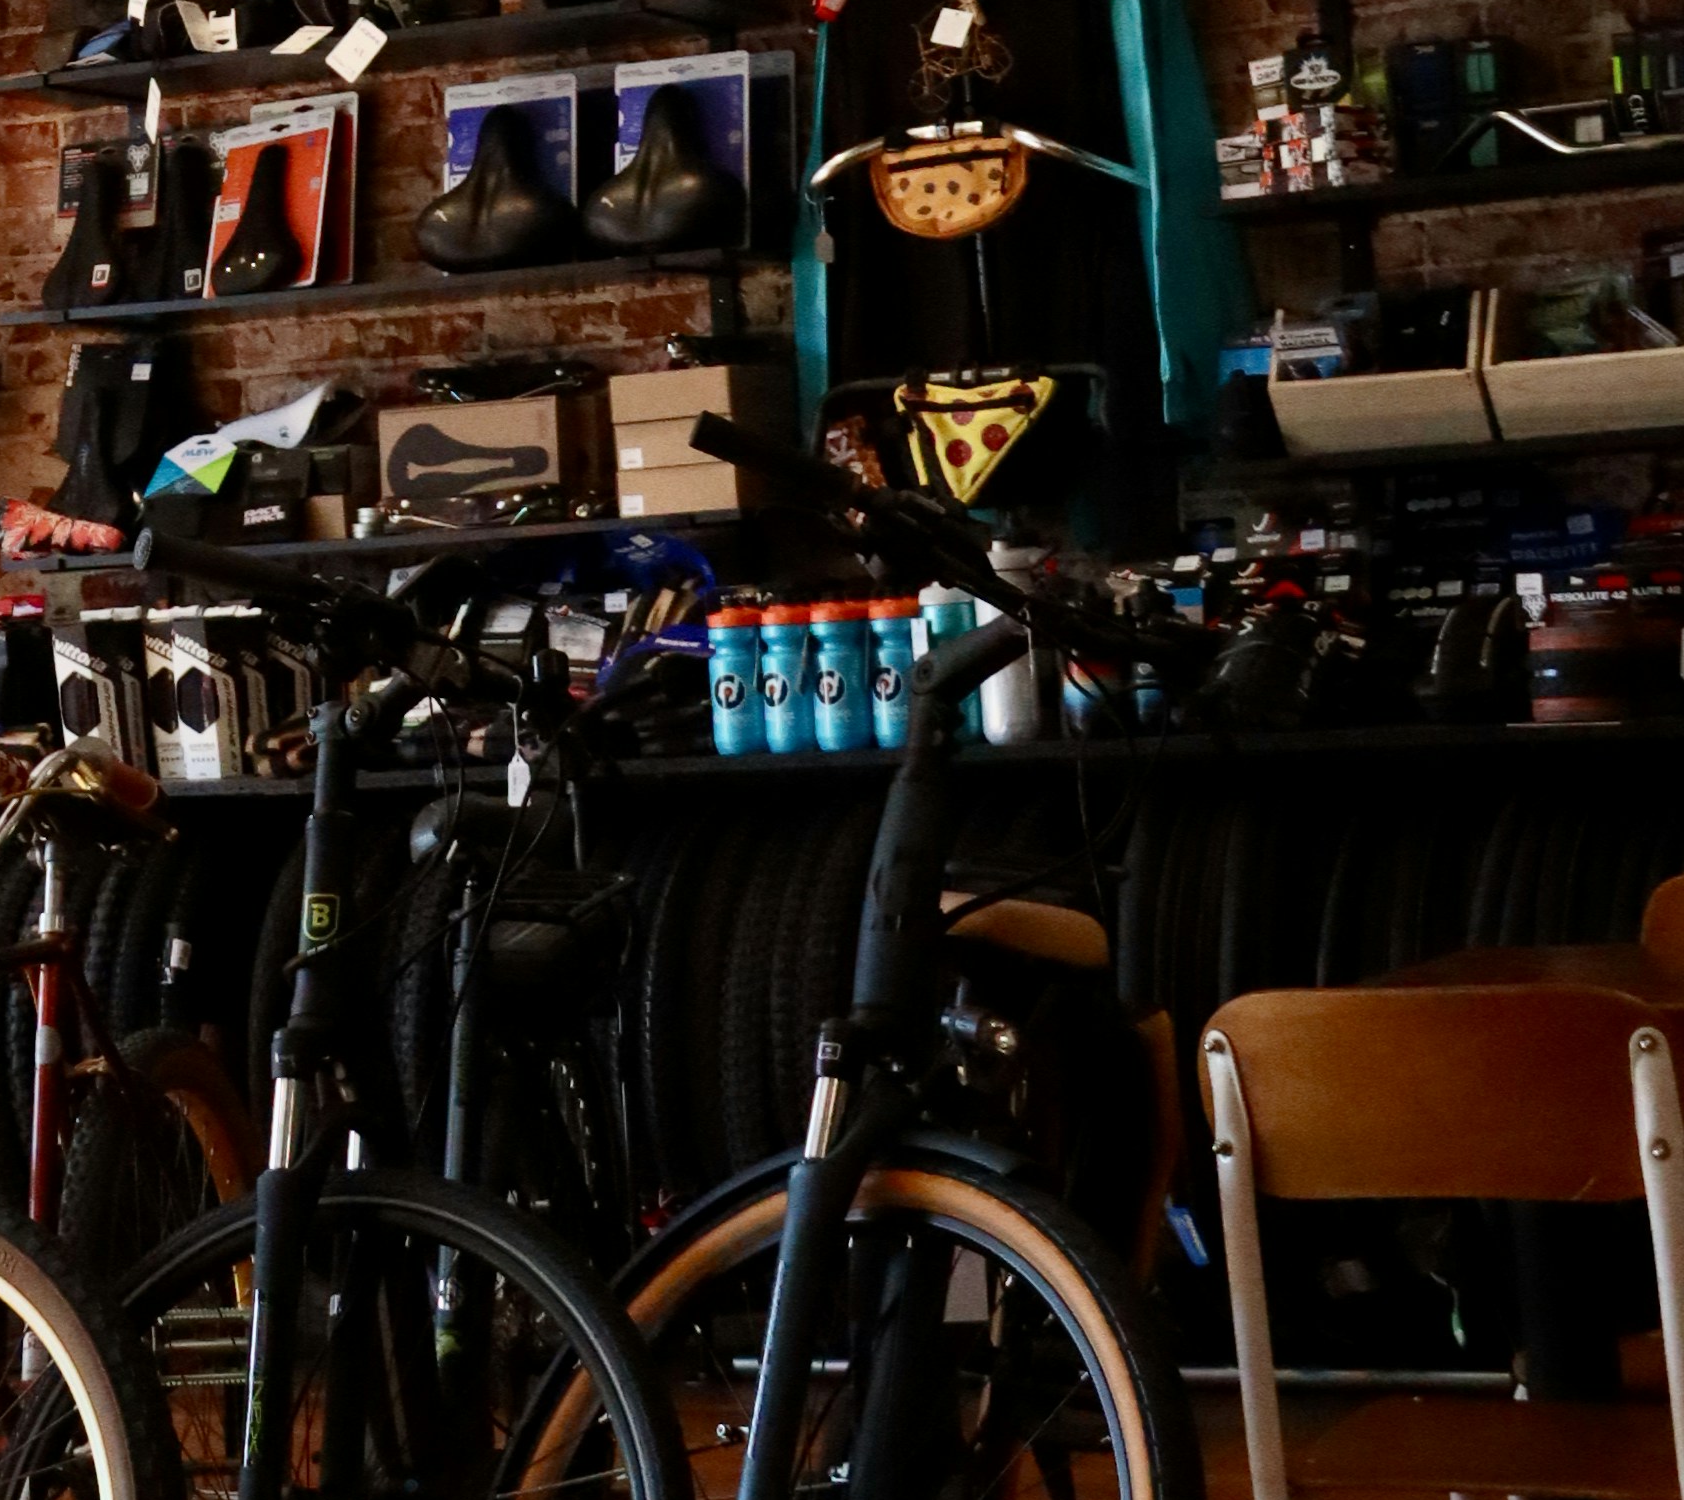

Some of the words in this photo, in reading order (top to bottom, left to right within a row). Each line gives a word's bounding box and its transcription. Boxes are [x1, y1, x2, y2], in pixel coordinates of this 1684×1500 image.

[1549, 590, 1610, 604] RESOLUTE
[1610, 590, 1628, 601] 42
[52, 634, 111, 674] vittoria
[172, 630, 228, 671] vittoria
[311, 903, 330, 928] B
